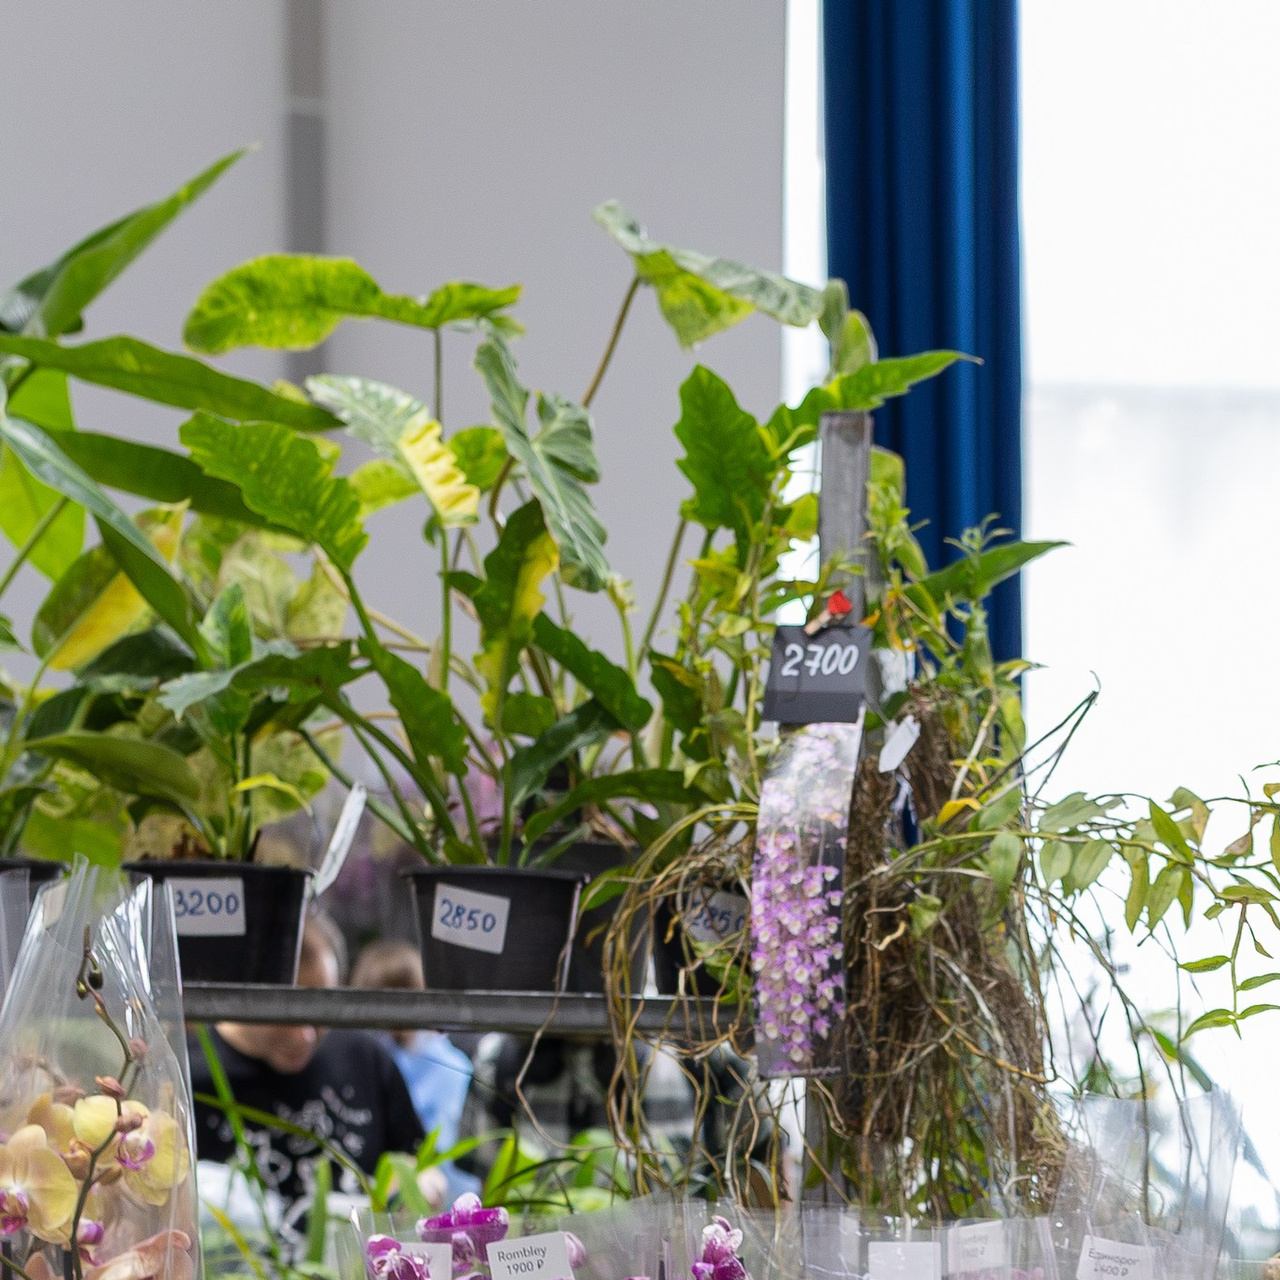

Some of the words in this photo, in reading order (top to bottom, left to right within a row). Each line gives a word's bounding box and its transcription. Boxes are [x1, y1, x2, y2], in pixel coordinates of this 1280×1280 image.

[781, 643, 858, 677] 2700
[174, 889, 240, 917] 3200
[438, 898, 497, 933] 2850
[497, 1246, 547, 1263] Rombley
[506, 1263, 534, 1276] 1900
